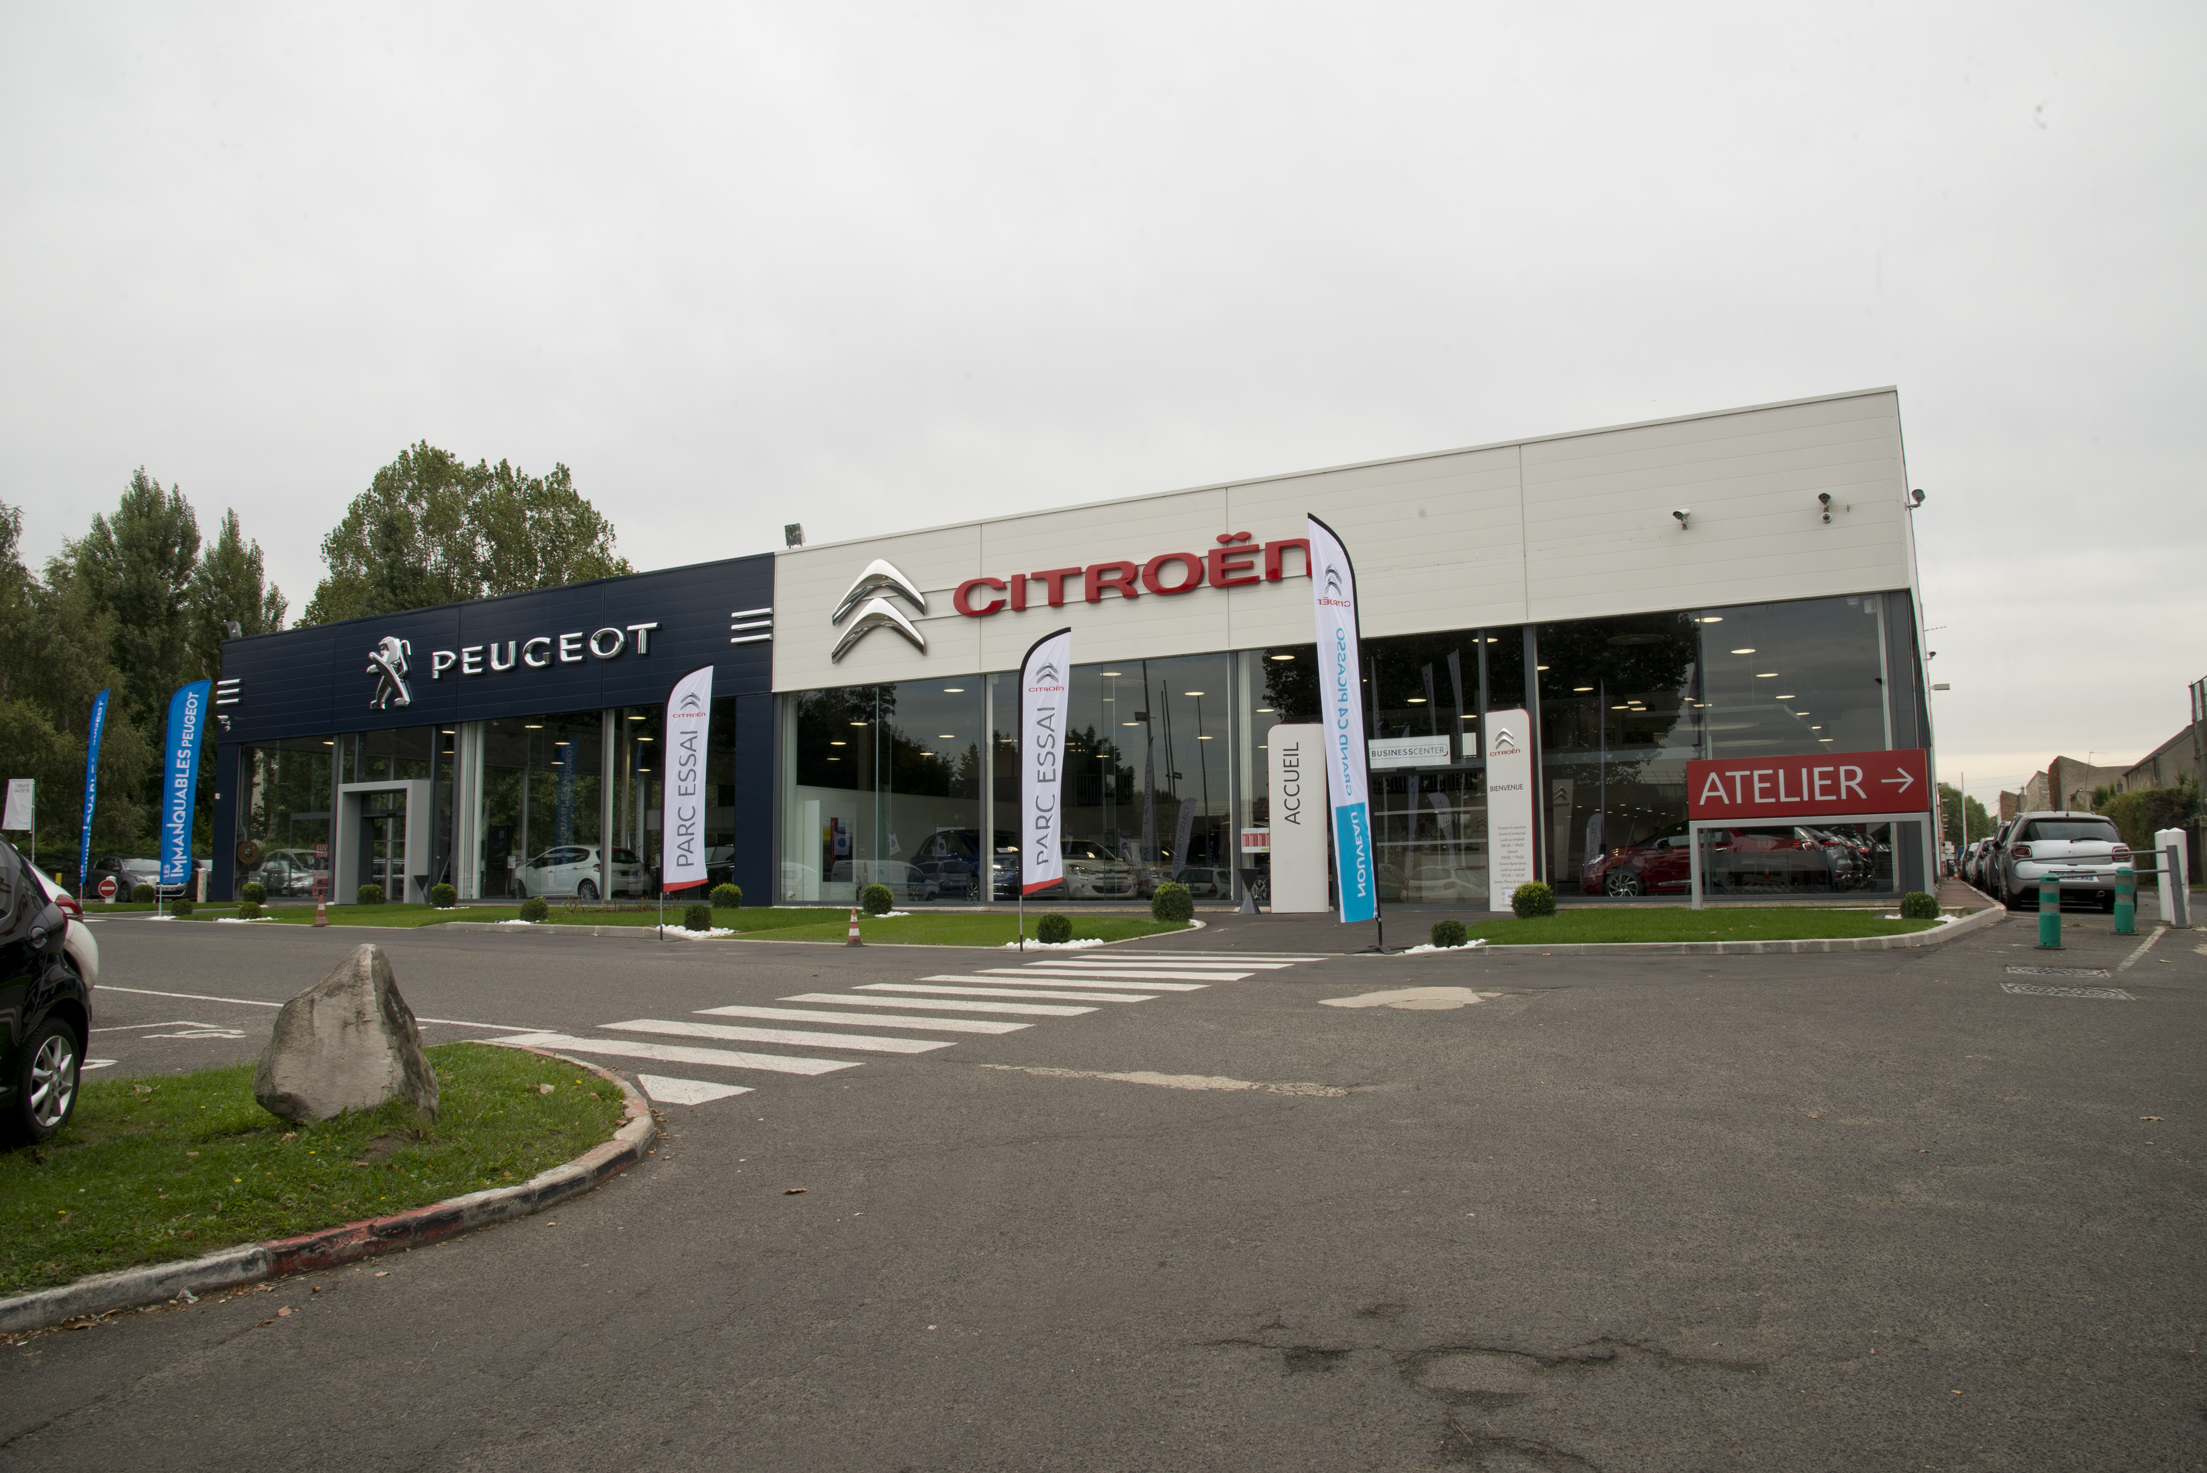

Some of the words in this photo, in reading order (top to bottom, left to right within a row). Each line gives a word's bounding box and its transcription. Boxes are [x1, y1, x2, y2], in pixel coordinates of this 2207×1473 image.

[953, 531, 1312, 618] CITROËN
[432, 621, 660, 680] PEUGEOT
[1028, 685, 1065, 693] CITROËN
[678, 730, 698, 796] ESSAI
[1036, 707, 1056, 783] ESSAI
[1371, 746, 1445, 758] BUSINESSCENTER
[1489, 748, 1521, 757] CITROËN
[166, 749, 192, 878] IMMANQUABLES
[181, 692, 200, 748] PEUGEOT
[1283, 742, 1301, 826] ACCUEIL
[1489, 783, 1524, 792] BIENVENUE
[1699, 765, 1867, 806] ATELIER
[676, 805, 696, 867] PARC
[1035, 794, 1056, 866] PARC
